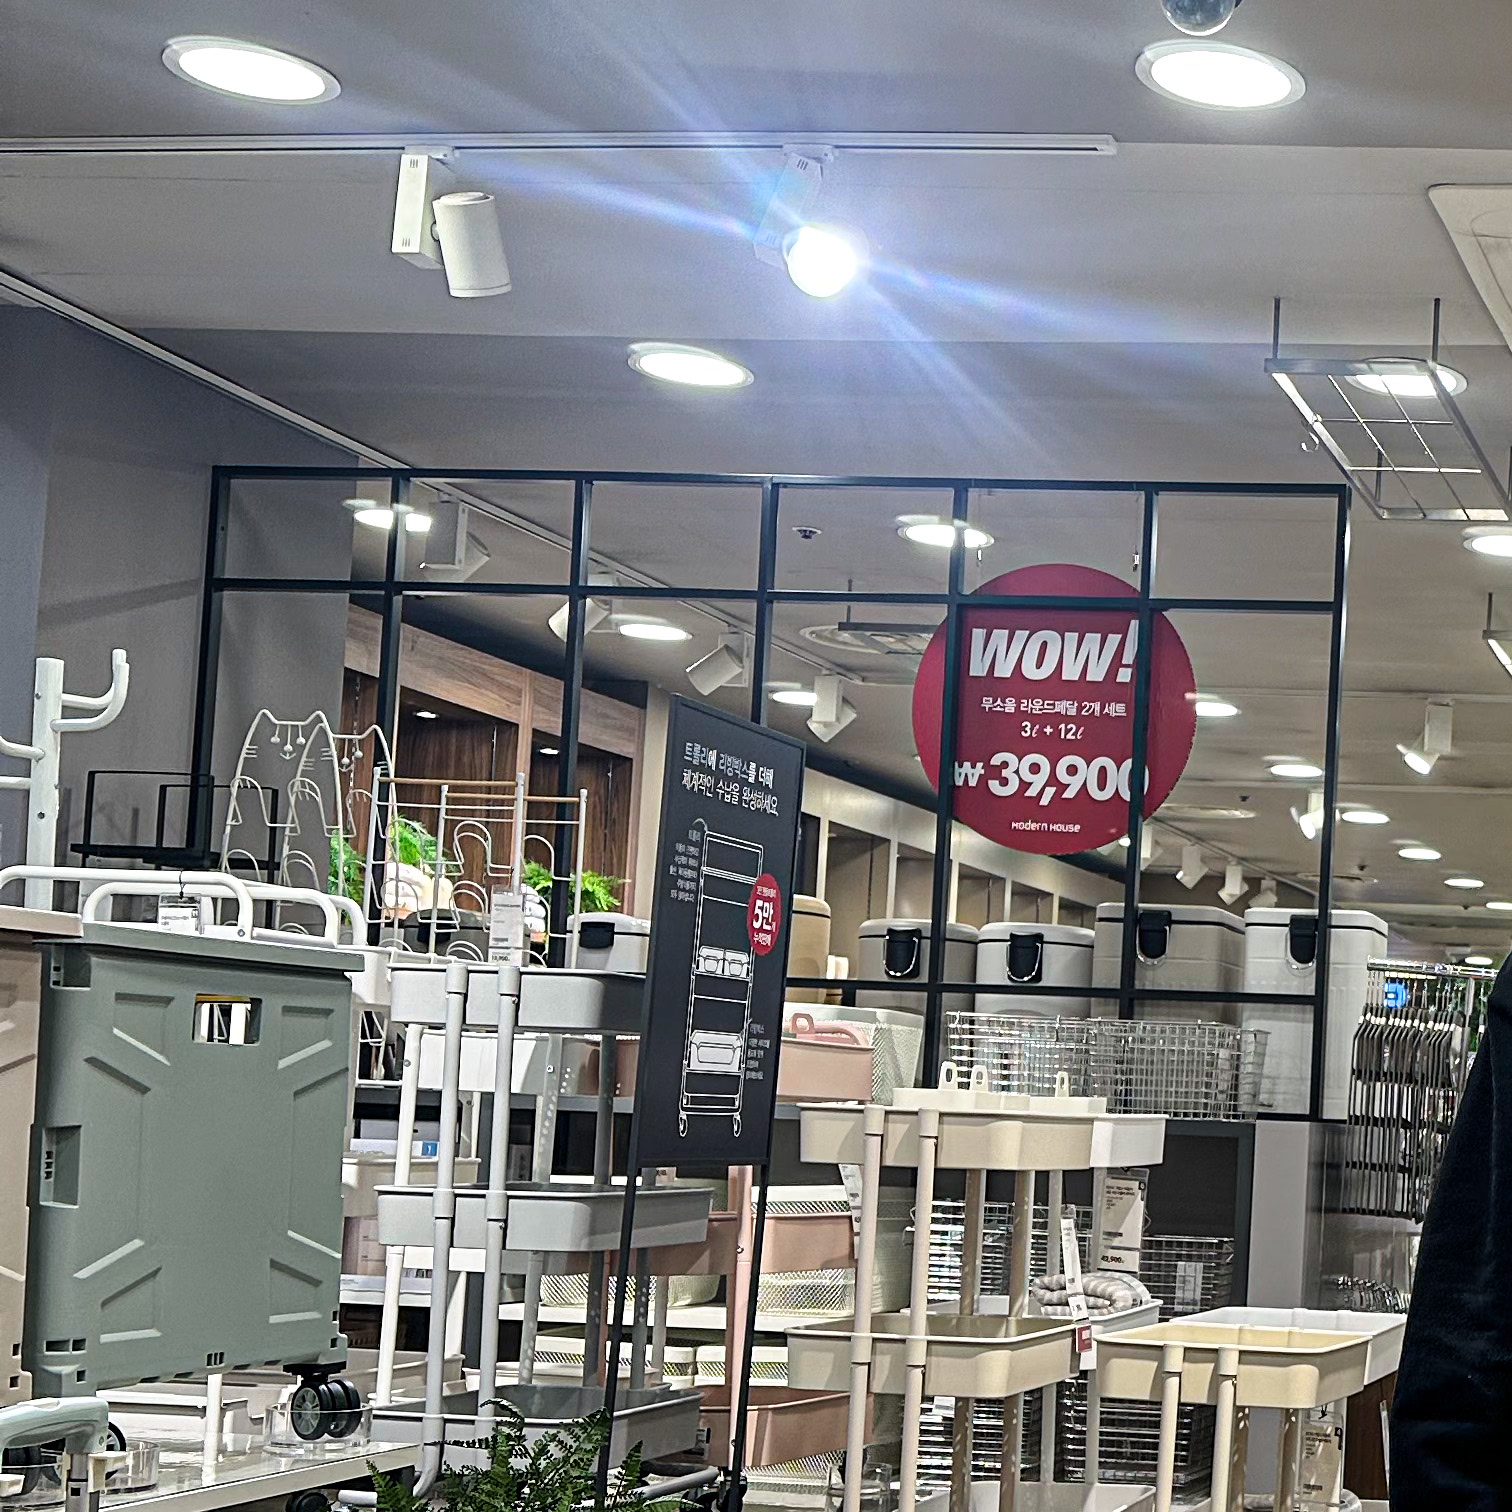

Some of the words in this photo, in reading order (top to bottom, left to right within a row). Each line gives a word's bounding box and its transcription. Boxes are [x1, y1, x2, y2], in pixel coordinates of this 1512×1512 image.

[969, 619, 1140, 683] WOW!
[981, 696, 1017, 713] 무소음
[1081, 701, 1101, 717] 2개
[1103, 702, 1127, 717] 세트
[716, 779, 740, 805] 수납을
